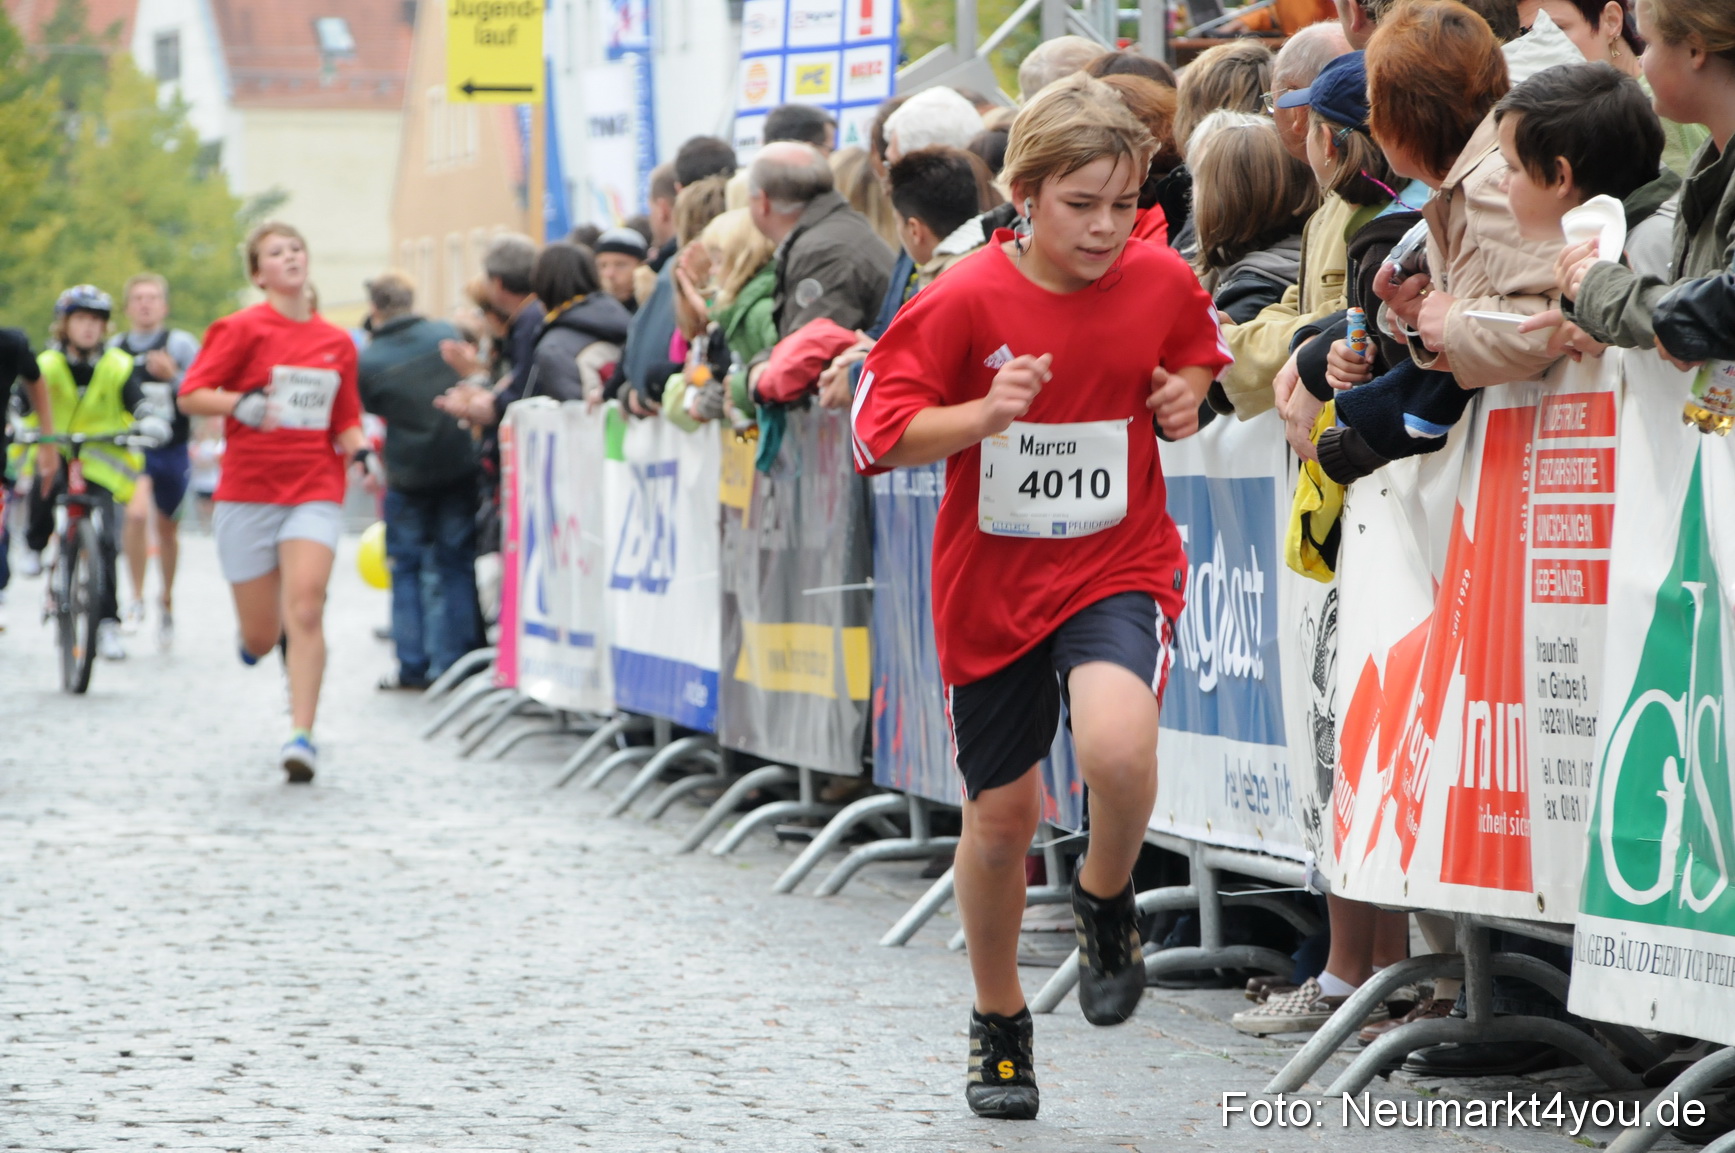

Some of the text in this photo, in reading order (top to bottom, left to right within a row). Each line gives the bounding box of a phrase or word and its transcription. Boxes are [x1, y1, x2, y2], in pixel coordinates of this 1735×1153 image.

[474, 23, 517, 46] lauf
[1020, 434, 1077, 456] Marco
[985, 463, 994, 479] J
[1018, 468, 1111, 499] 4010
[1068, 516, 1122, 531] PFLEIDERE
[1458, 568, 1471, 606] 1929
[1582, 675, 1588, 701] 8
[998, 1060, 1015, 1079] S
